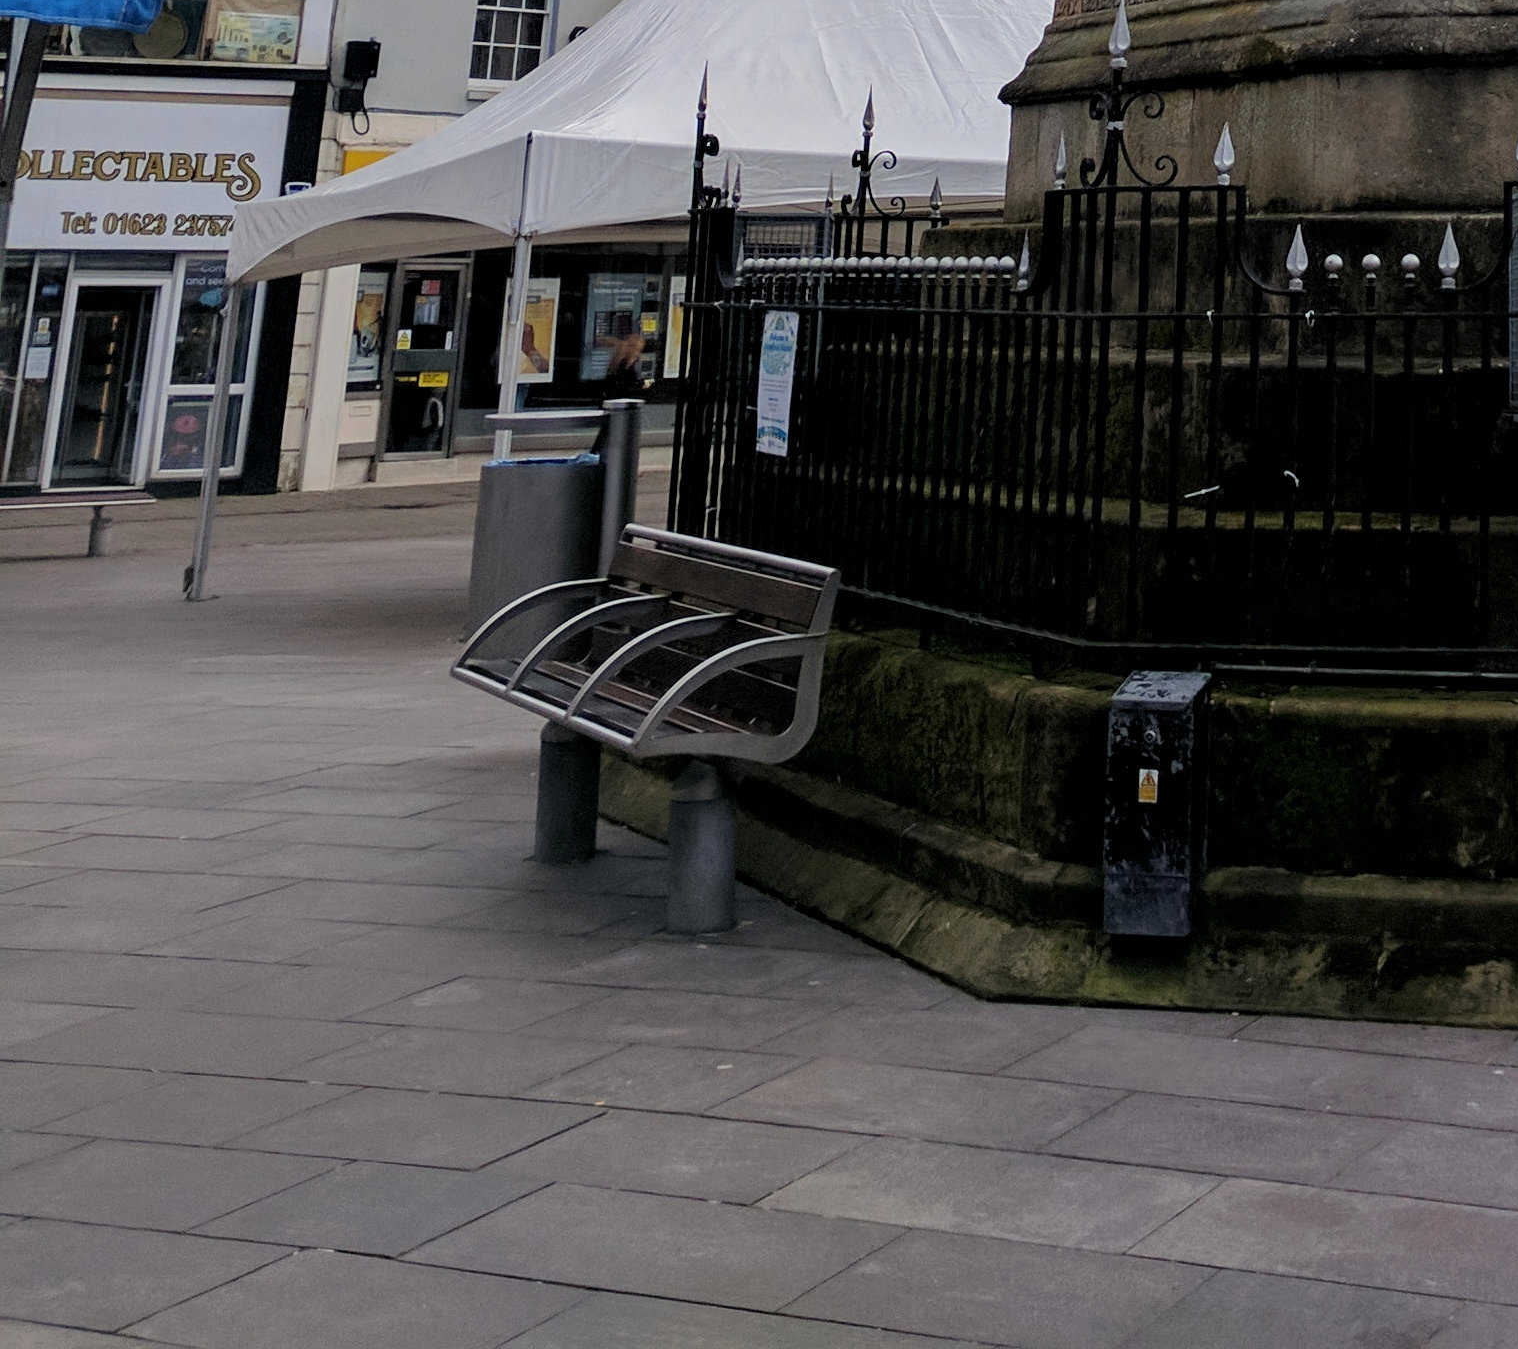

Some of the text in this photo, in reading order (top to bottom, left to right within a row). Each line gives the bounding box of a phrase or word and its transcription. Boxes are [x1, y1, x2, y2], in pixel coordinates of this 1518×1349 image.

[15, 149, 262, 201] OLLECTABLES
[102, 212, 167, 236] 01623
[172, 214, 236, 237] 23757
